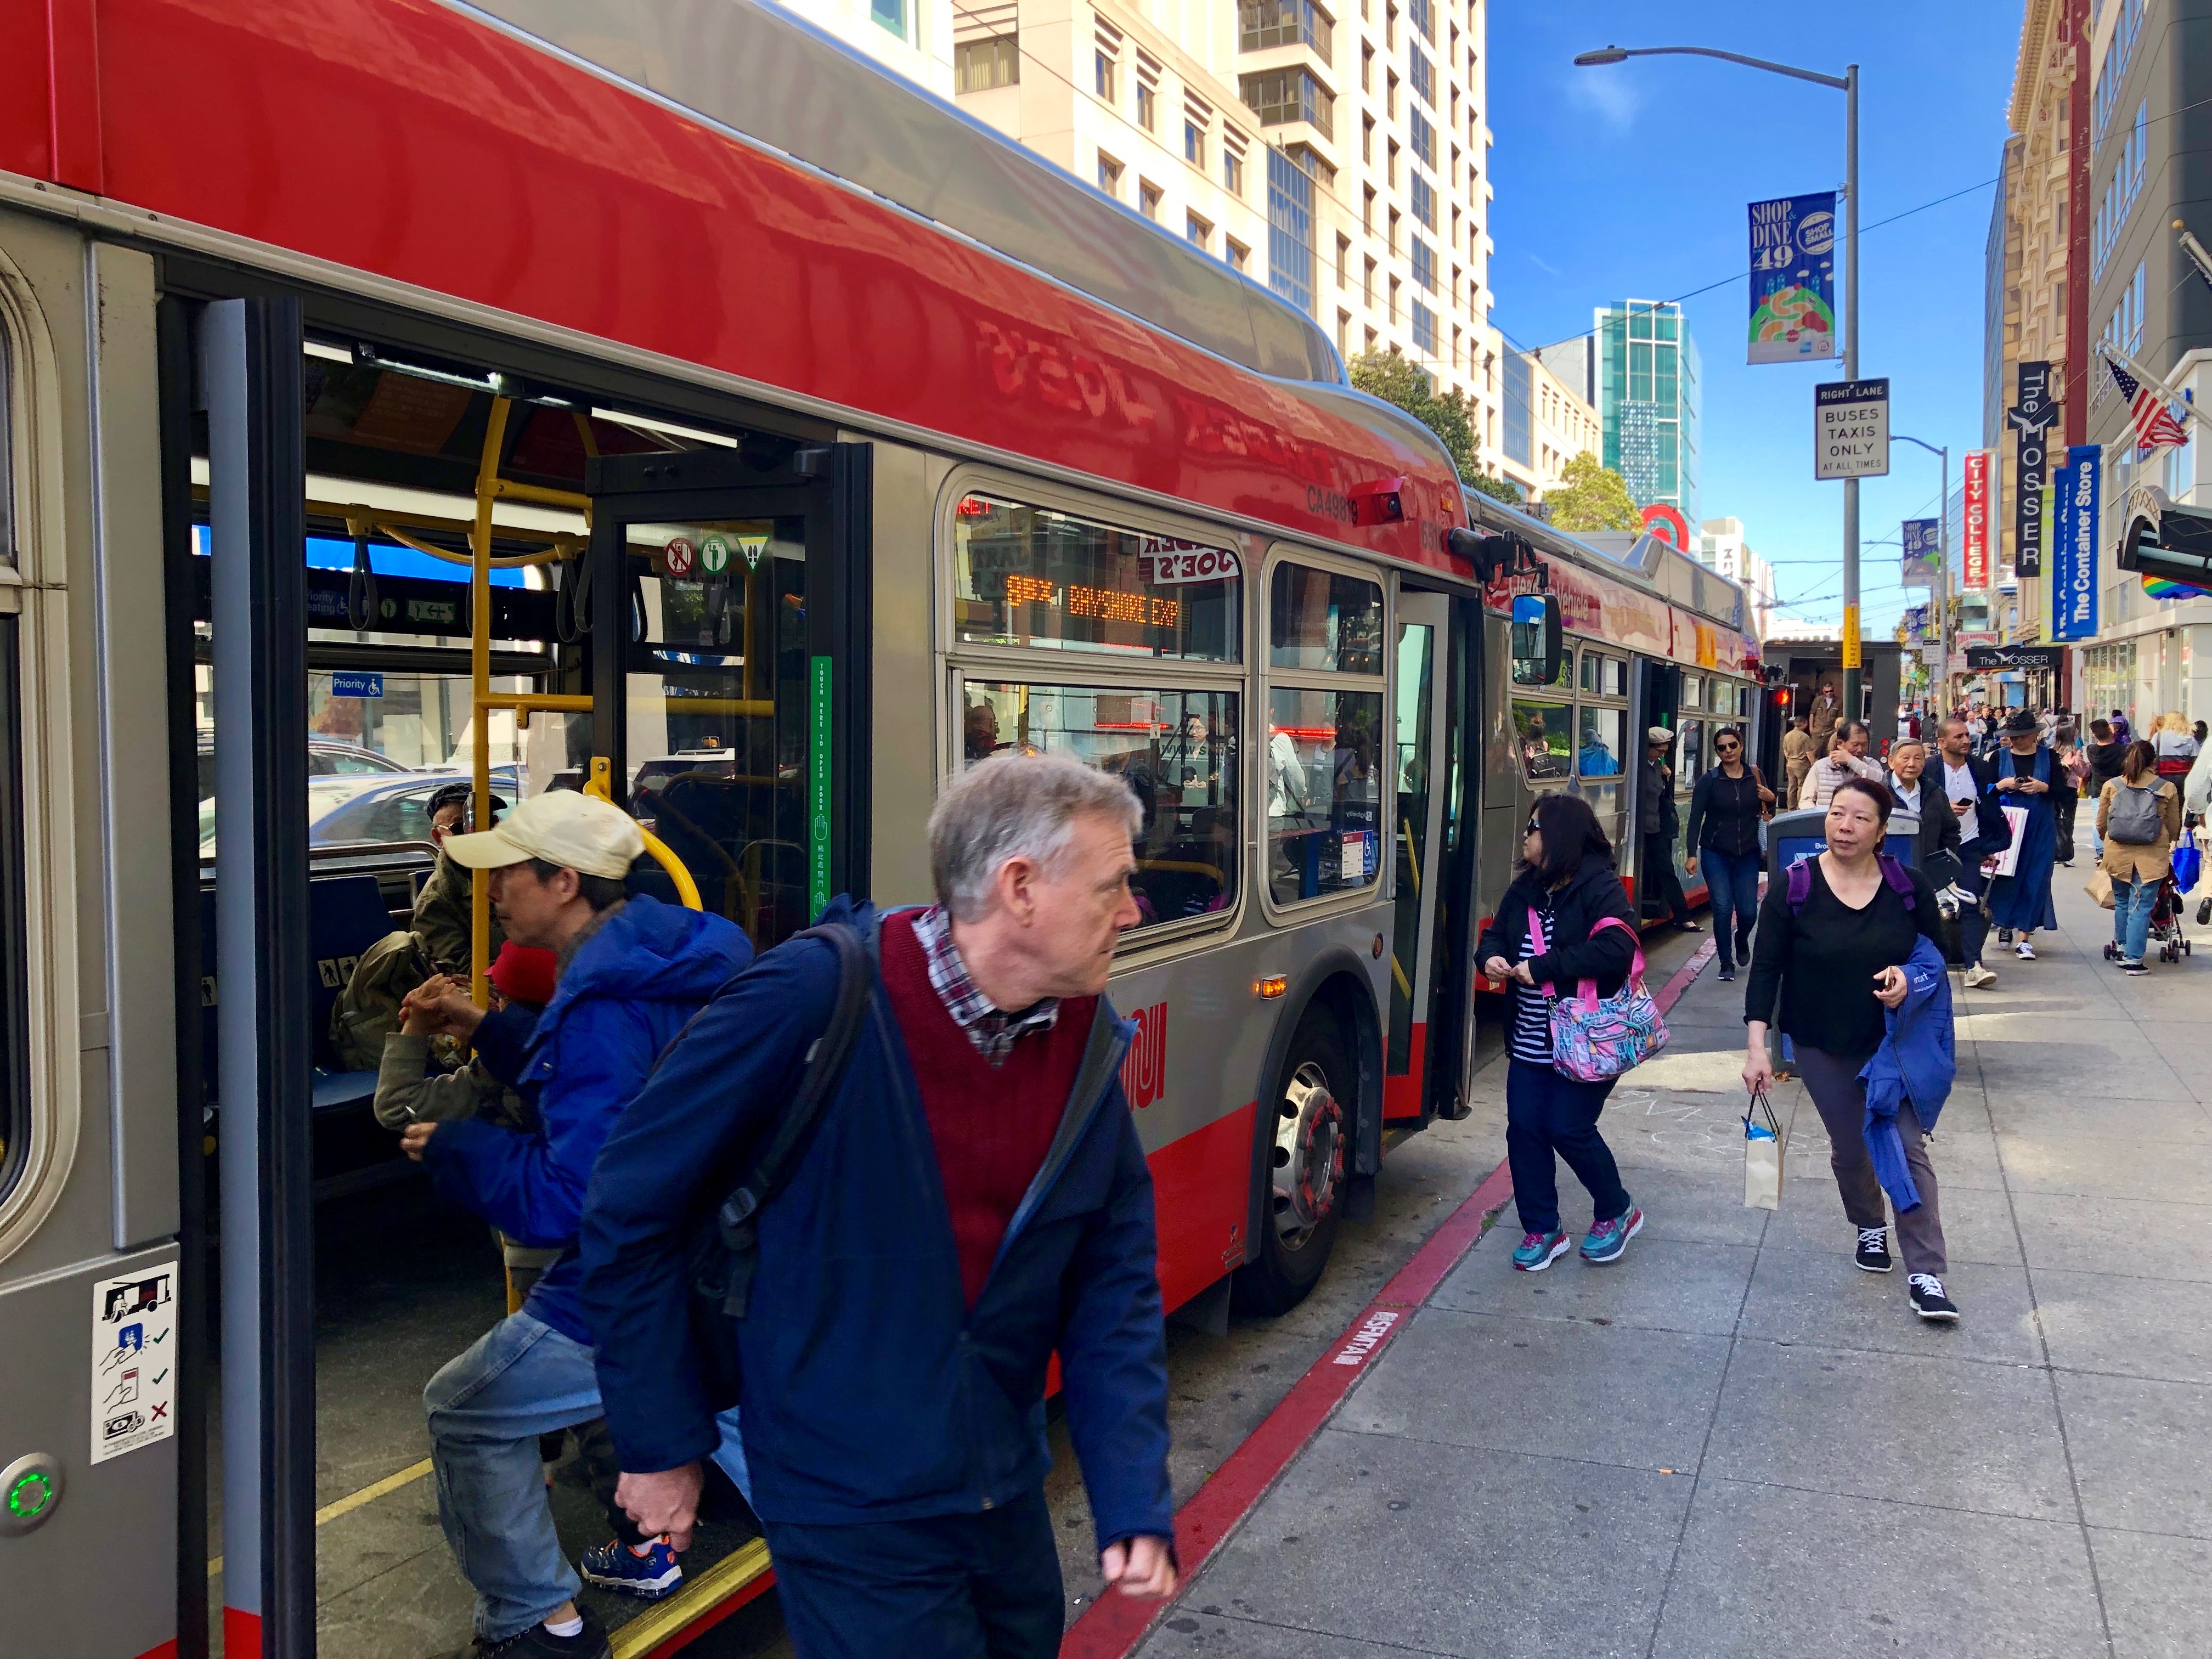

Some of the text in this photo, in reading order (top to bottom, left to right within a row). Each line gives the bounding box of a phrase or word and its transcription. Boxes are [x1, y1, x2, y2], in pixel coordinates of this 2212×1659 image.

[1752, 201, 1792, 225] SHOP
[1753, 222, 1792, 249] DINE
[1805, 222, 1830, 238] SHOP
[1805, 229, 1833, 245] SMALL
[1753, 245, 1793, 270] 49
[1821, 386, 1883, 400] RIGHT LANE
[1826, 409, 1878, 423] BUSES
[1828, 426, 1875, 439] TAXIS
[1830, 443, 1874, 456] ONLY
[1823, 459, 1881, 471] AT ALL TIMES
[2016, 370, 2047, 566] The MOSSER
[1969, 459, 1984, 500] CITY
[1968, 504, 1984, 577] COLLEGE
[2074, 461, 2093, 623] The Container Store
[307, 591, 334, 603] riority
[1556, 580, 1589, 620] Vehicle
[307, 603, 335, 614] eating
[1070, 585, 1147, 624] BAYSHORE
[1152, 597, 1178, 627] EXP
[1980, 657, 1997, 665] The
[1998, 652, 2049, 665] MOSSER
[334, 678, 365, 691] Priority
[819, 734, 824, 747] TO
